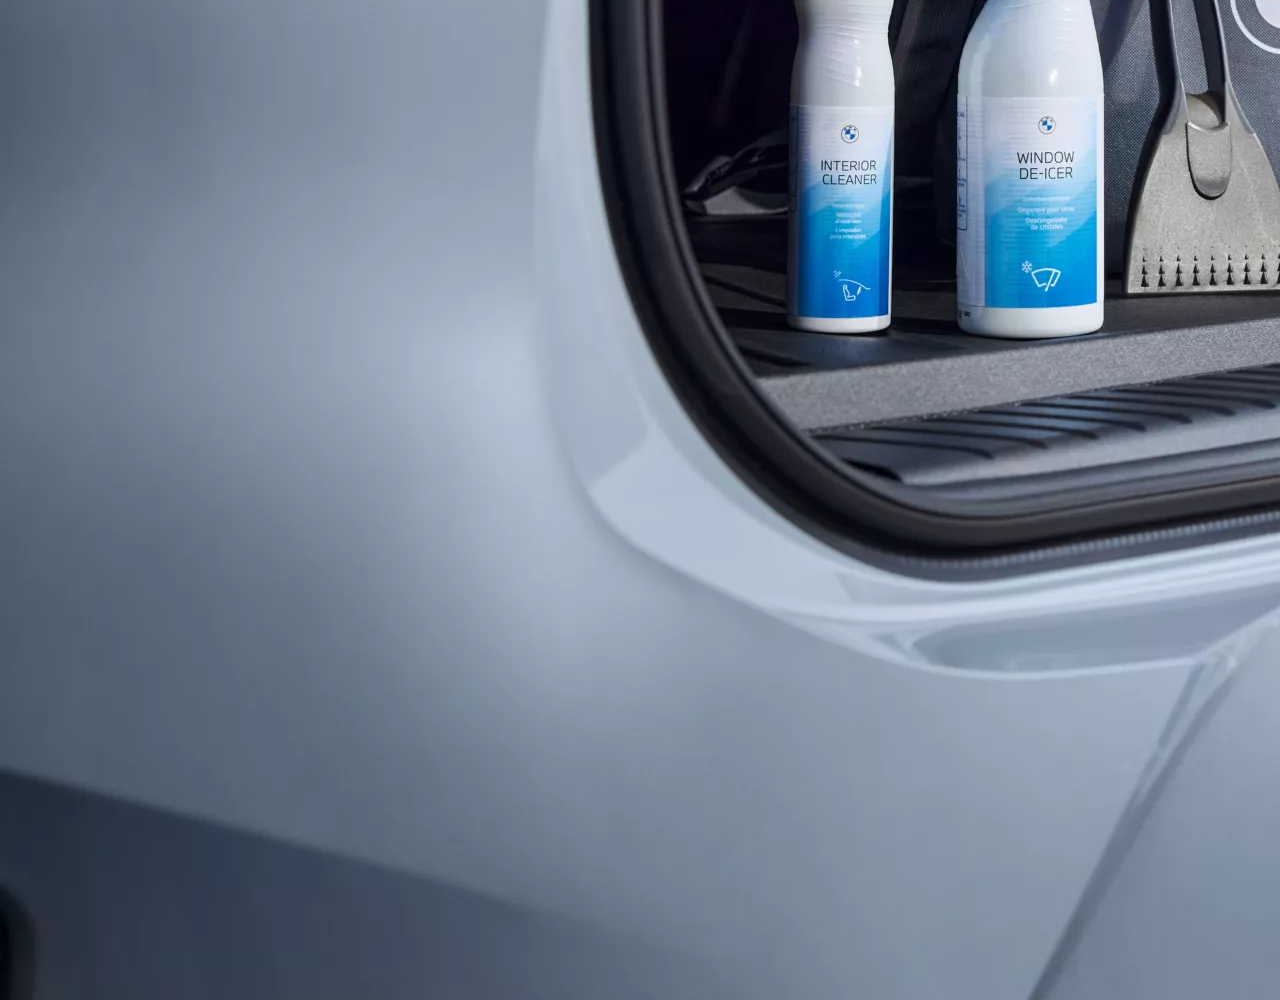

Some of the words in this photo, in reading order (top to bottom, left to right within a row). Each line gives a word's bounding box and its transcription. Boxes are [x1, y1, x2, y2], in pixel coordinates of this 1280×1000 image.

[1016, 151, 1075, 164] WINDOW
[821, 160, 877, 172] INTERIOR
[822, 173, 877, 186] CLEANER
[1019, 167, 1073, 180] DE-ICER
